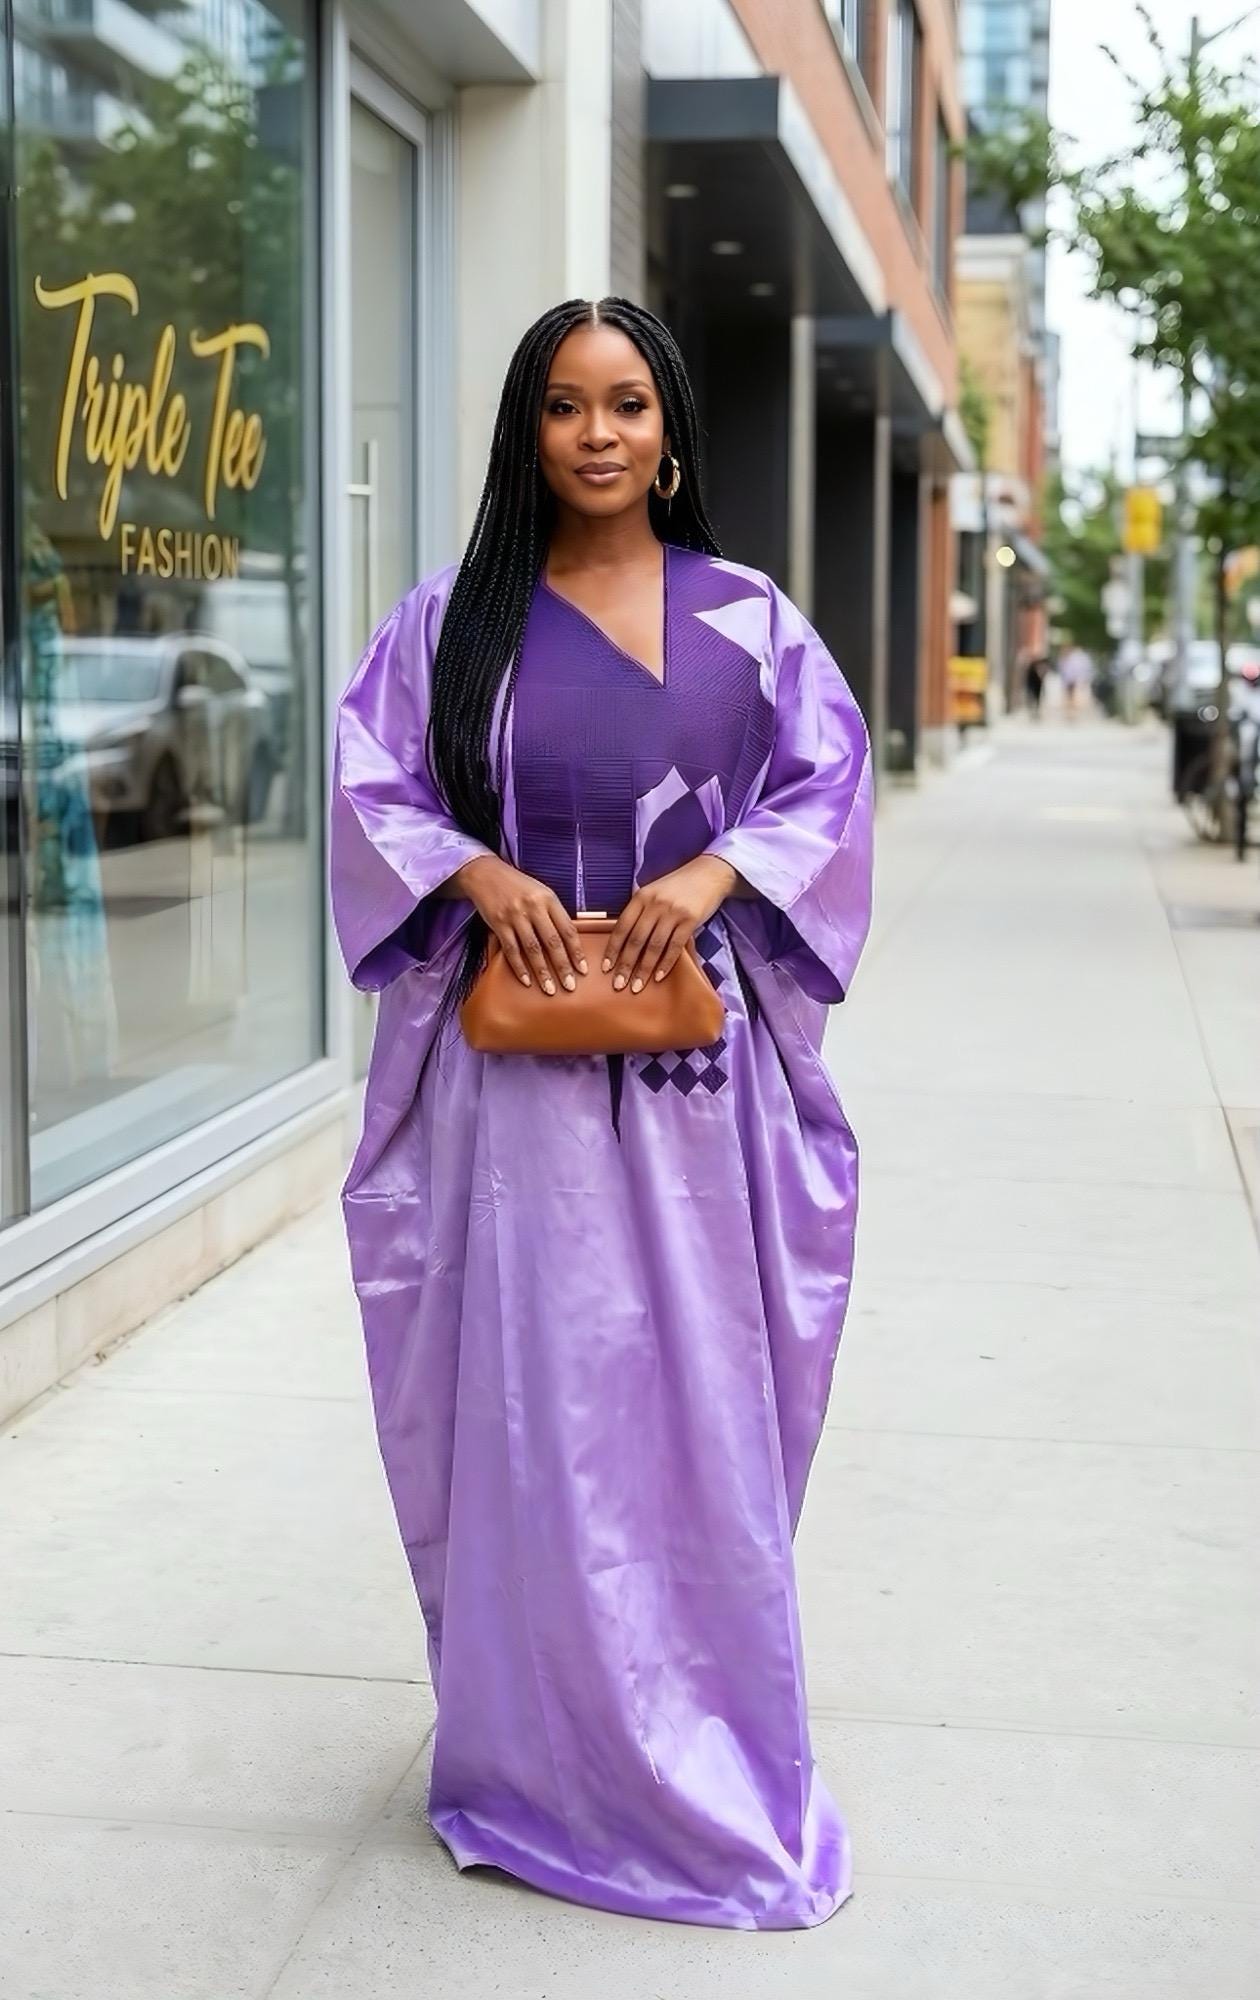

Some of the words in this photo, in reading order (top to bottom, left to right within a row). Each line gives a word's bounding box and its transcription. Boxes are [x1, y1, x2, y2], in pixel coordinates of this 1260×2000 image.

[35, 273, 190, 540] Triple
[191, 324, 270, 520] Tee
[121, 523, 239, 580] FASHION
